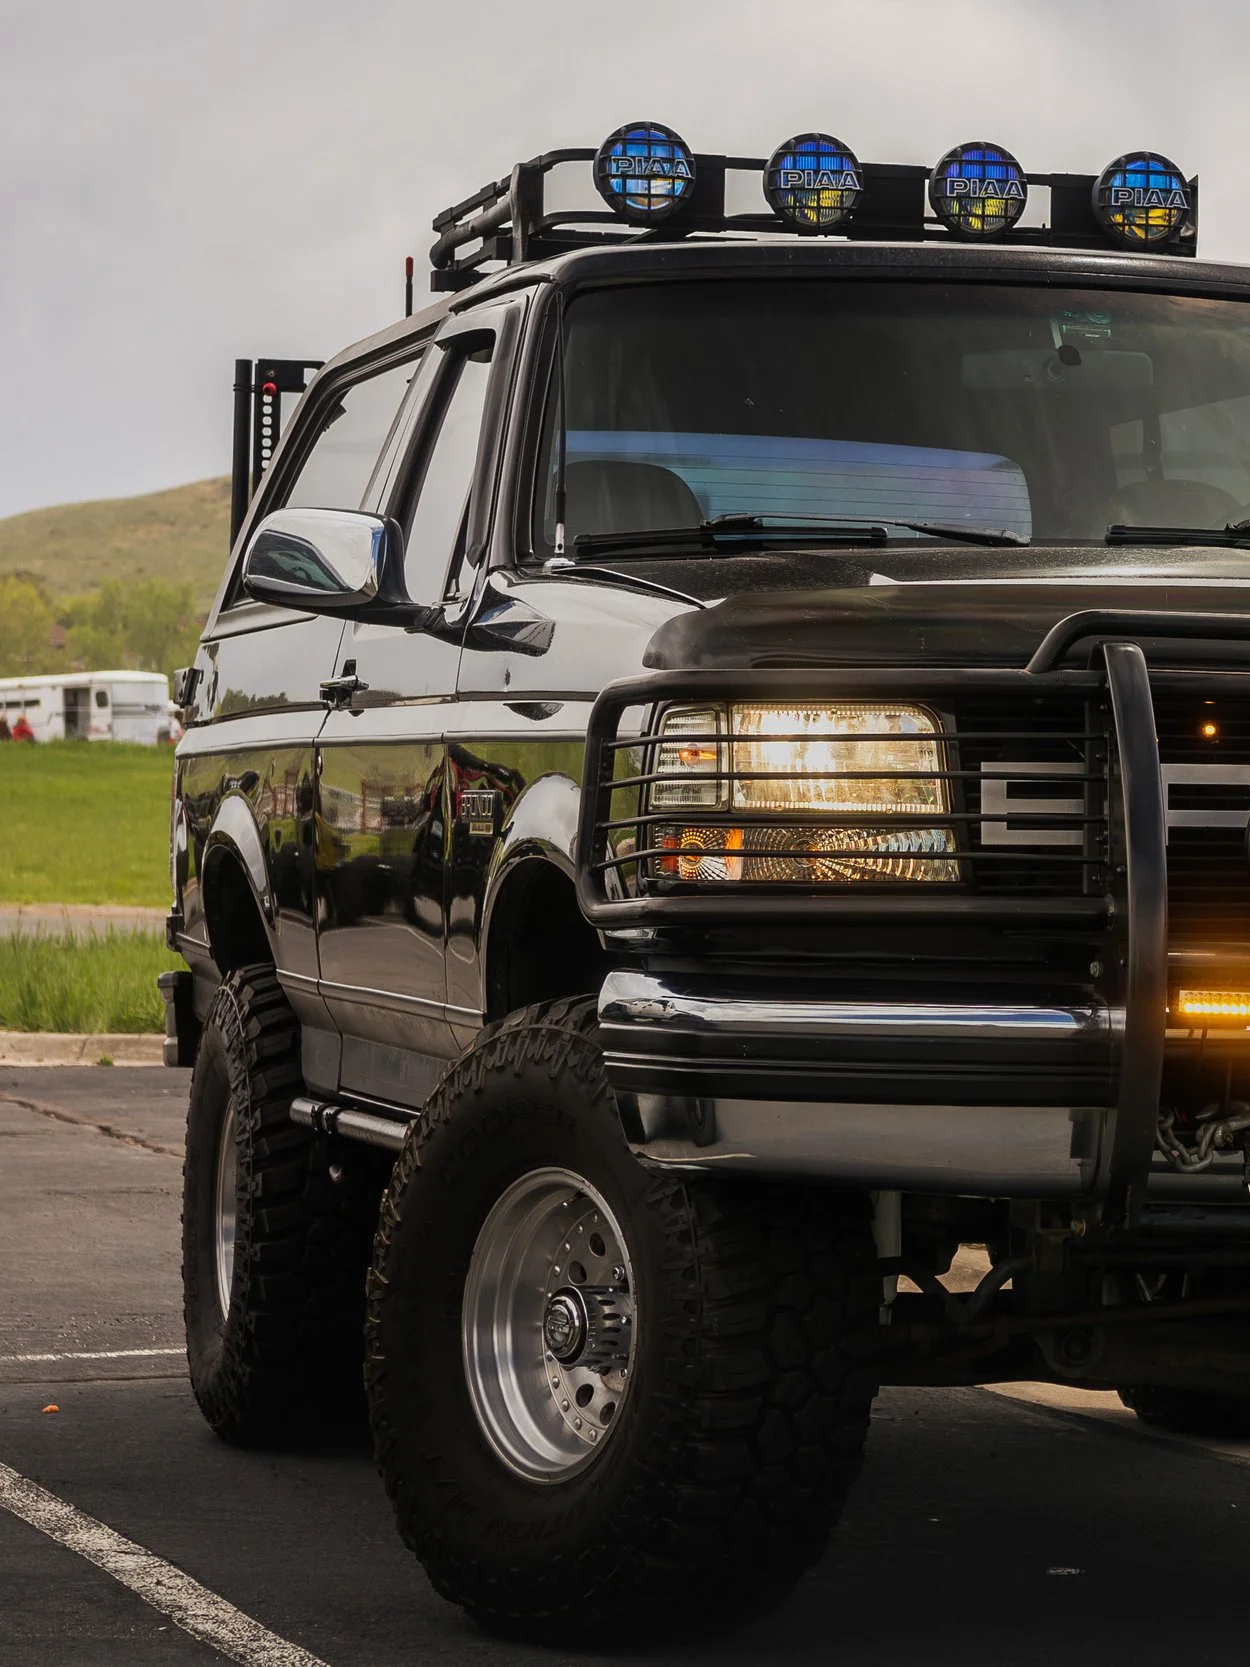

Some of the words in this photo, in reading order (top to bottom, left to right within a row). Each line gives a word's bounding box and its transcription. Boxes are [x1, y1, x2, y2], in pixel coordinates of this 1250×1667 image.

[611, 156, 691, 178] PIAA
[780, 170, 860, 190] PIAA
[946, 178, 1025, 199] PIAA
[1111, 187, 1188, 209] PIAA
